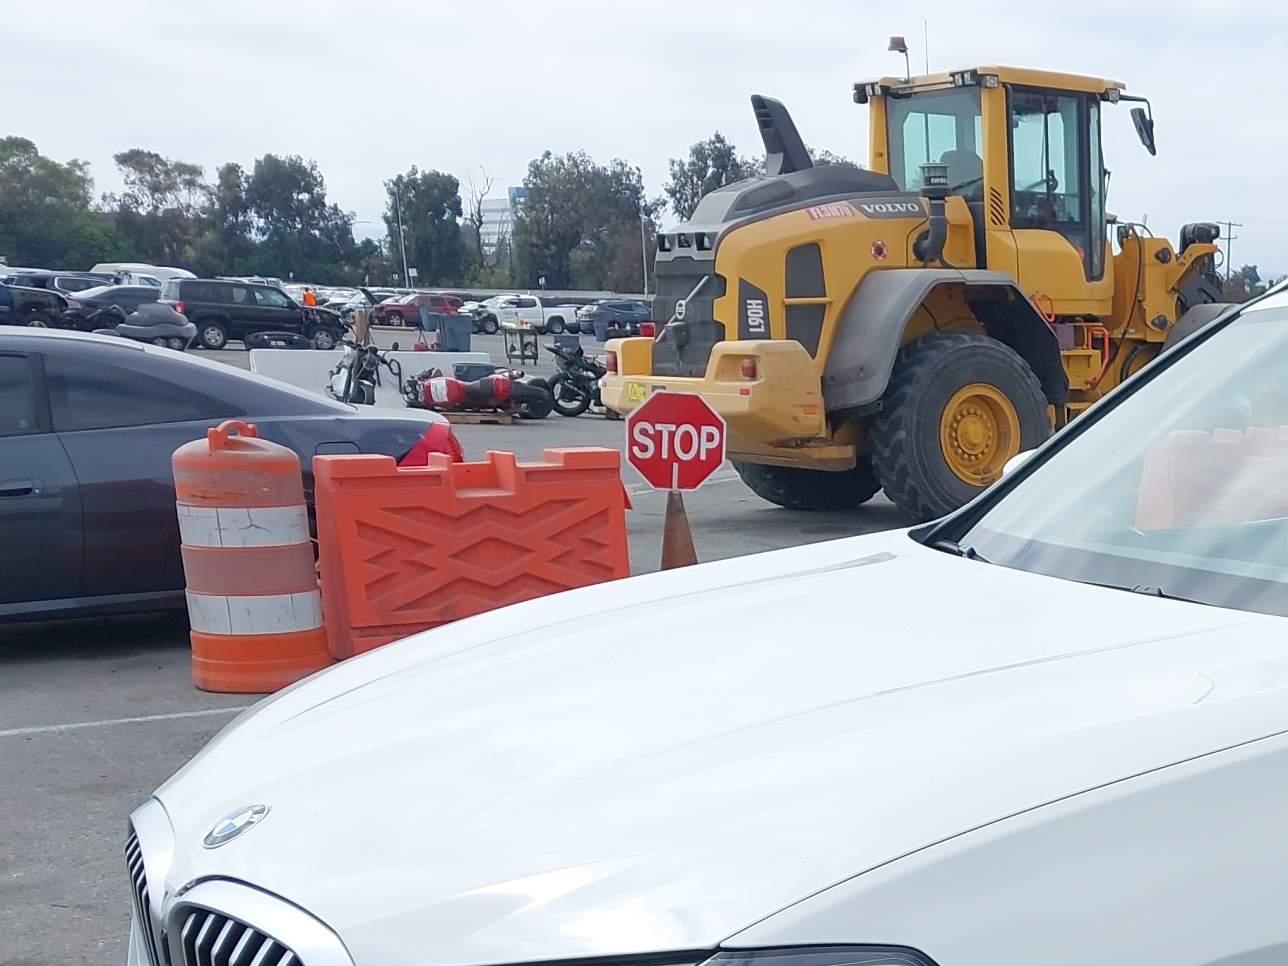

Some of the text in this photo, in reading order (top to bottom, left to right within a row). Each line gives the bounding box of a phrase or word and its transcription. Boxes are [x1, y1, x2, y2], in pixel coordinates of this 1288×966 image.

[860, 202, 920, 213] VOLVO
[746, 299, 765, 333] L90H
[631, 421, 720, 461] STOP
